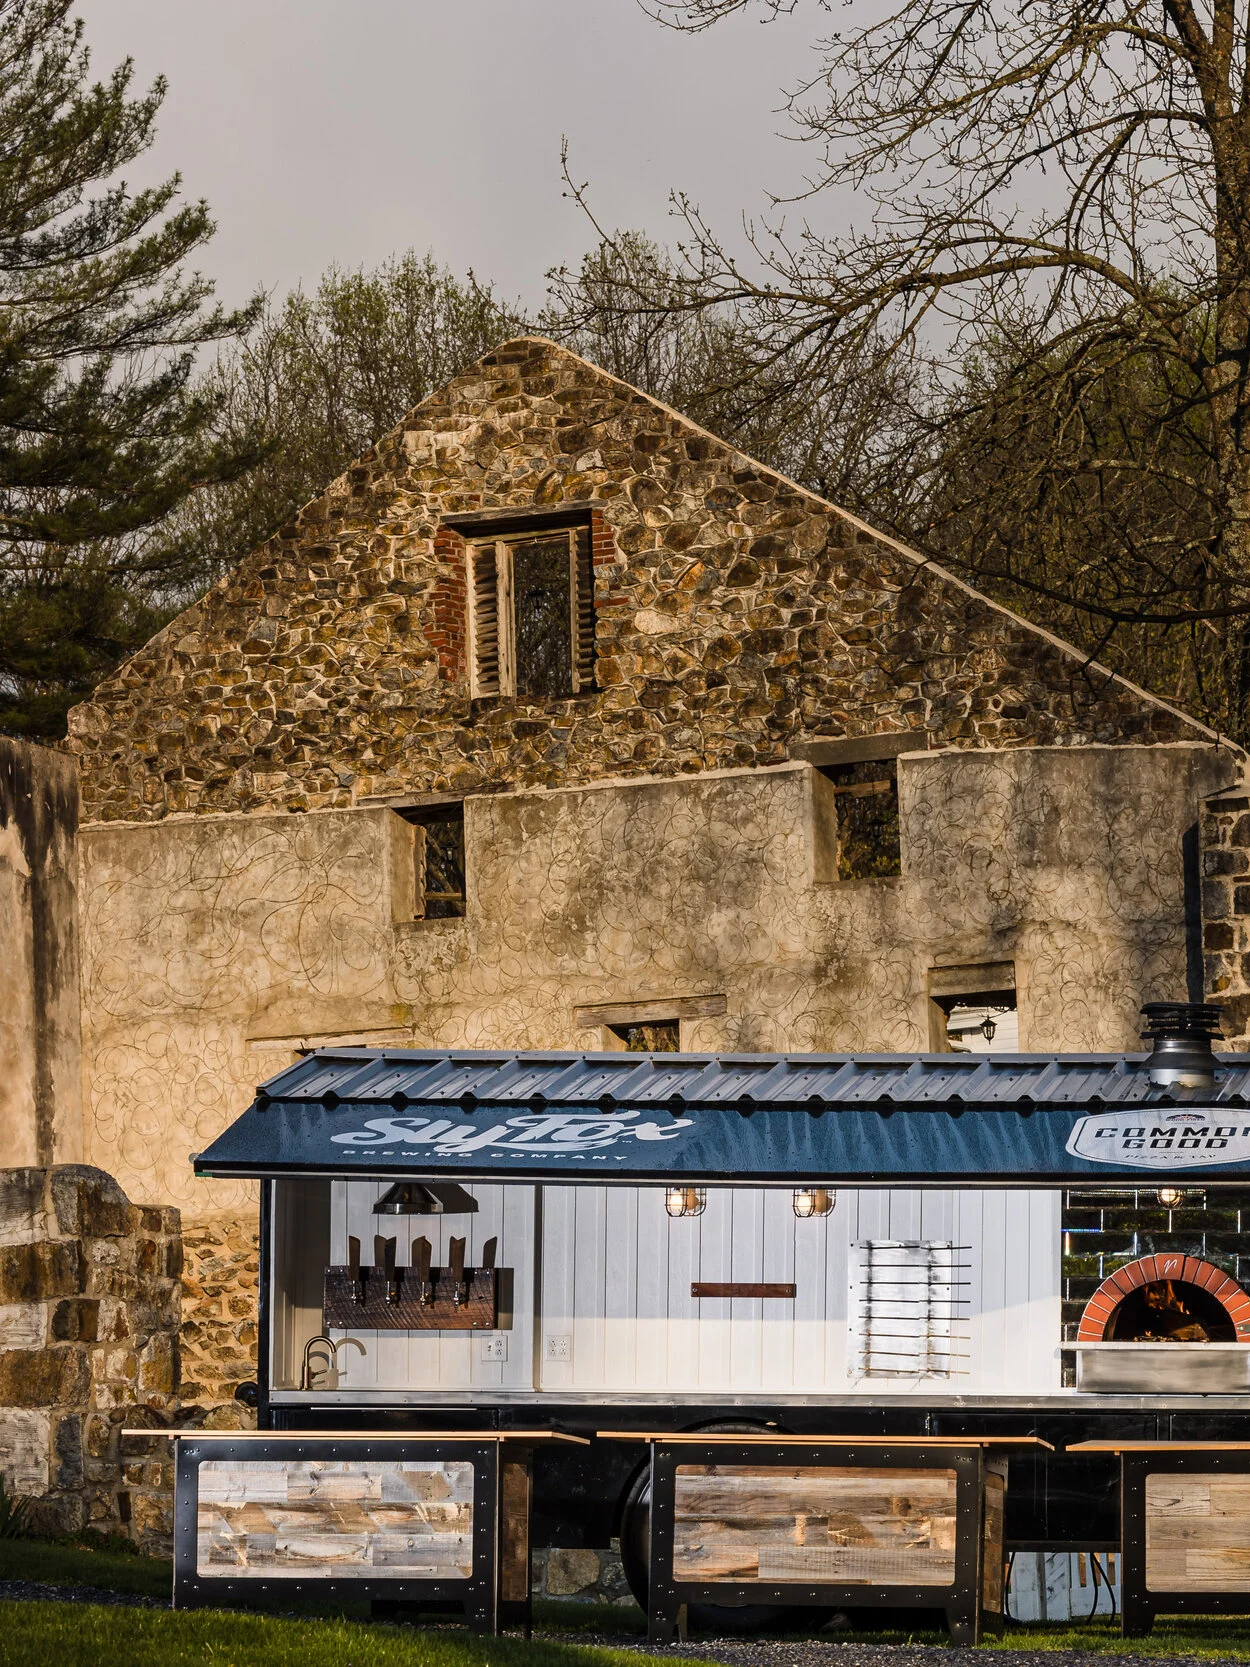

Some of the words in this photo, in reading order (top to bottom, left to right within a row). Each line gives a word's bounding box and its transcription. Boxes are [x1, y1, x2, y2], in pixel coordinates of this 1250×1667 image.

[1121, 1138, 1229, 1149] GOOD
[342, 1150, 473, 1158] BREWING
[490, 1153, 629, 1161] COMPANY
